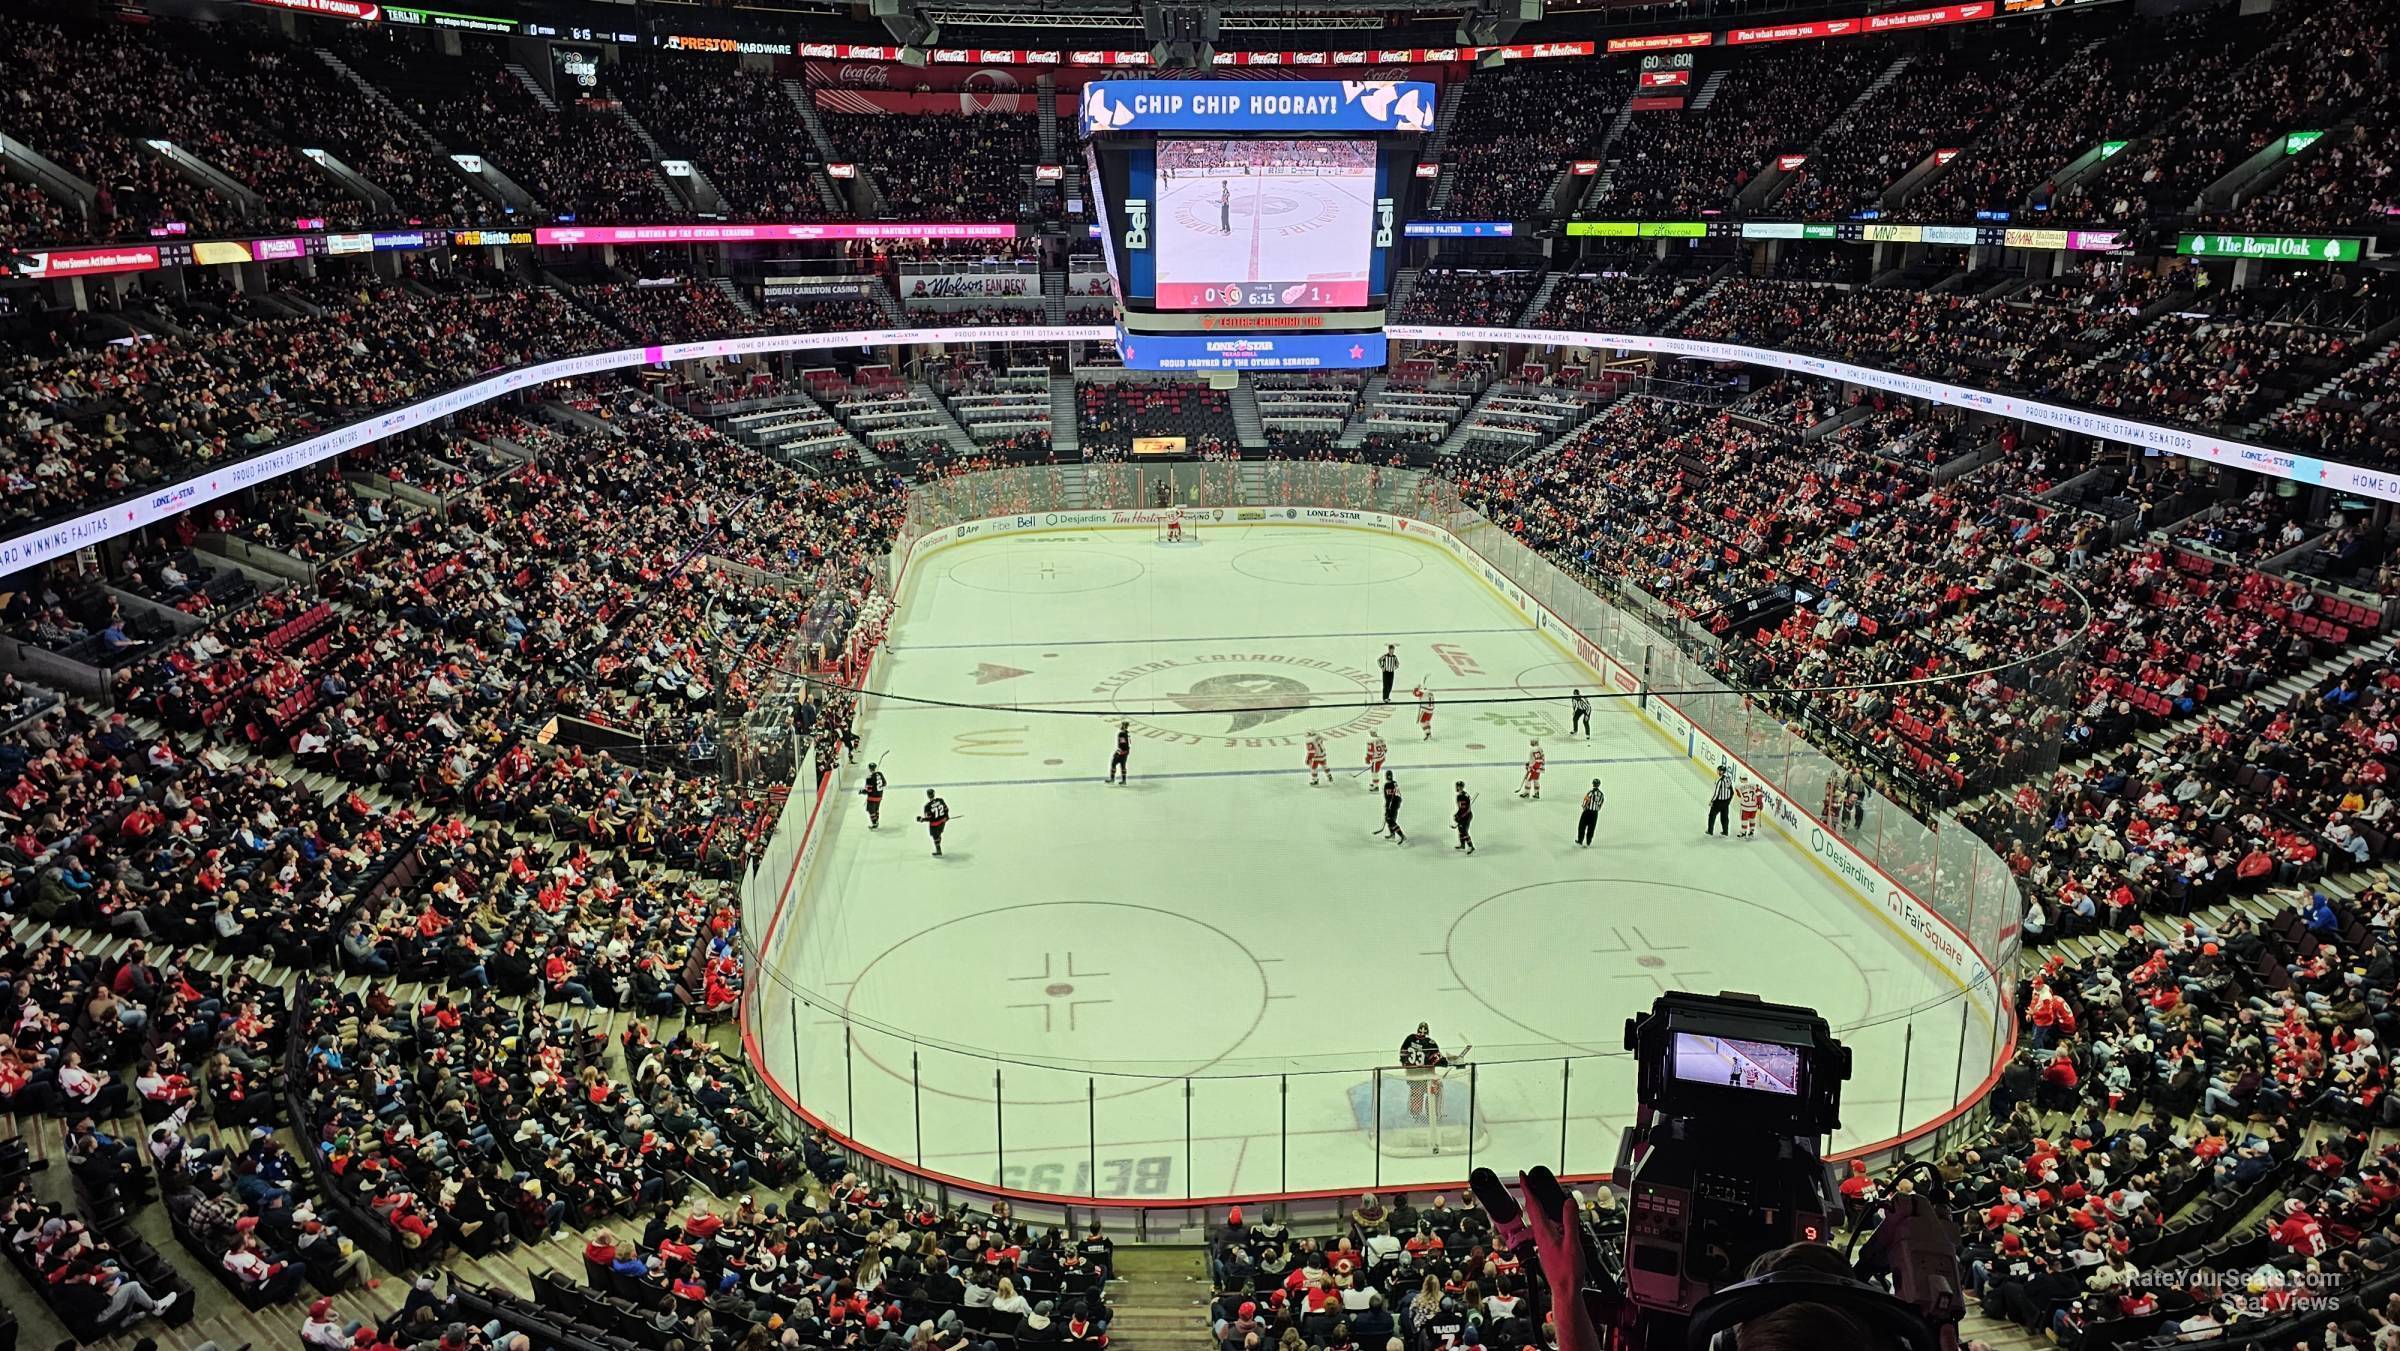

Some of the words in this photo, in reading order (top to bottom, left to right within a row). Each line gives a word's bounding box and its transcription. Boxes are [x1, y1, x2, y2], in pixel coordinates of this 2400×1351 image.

[1889, 16, 1907, 26] what
[1908, 14, 1930, 24] moves
[1931, 12, 1945, 22] you
[1755, 30, 1774, 39] what
[1774, 28, 1797, 38] moves
[1798, 26, 1812, 36] you
[679, 37, 736, 52] PRESTON
[736, 42, 791, 55] HARDWARE
[1627, 39, 1645, 48] what
[1646, 38, 1668, 47] moves
[1668, 37, 1683, 47] you
[1533, 45, 1550, 57] Tim
[1550, 45, 1582, 57] Hortons
[565, 62, 596, 76] SENS
[840, 65, 888, 83] Coca-Cola
[1135, 95, 1183, 114] CHIP
[1192, 95, 1240, 114] CHIP
[1251, 95, 1337, 114] HOORAY!
[1125, 199, 1147, 249] Bell
[1377, 198, 1394, 248] Bell
[1872, 227, 1898, 240] MNP
[1928, 227, 1970, 242] TechInsights
[2006, 232, 2034, 245] RE/MAX
[2217, 236, 2241, 252] The
[2242, 238, 2280, 257] Royal
[2282, 239, 2310, 256] Oak
[764, 285, 792, 296] RIDEAU
[793, 285, 831, 295] CARLETON
[832, 284, 859, 294] CASINO
[927, 277, 983, 296] Molson
[1205, 288, 1215, 301] 0
[1249, 294, 1275, 305] 6:15
[1312, 288, 1320, 301] 1
[1207, 342, 1235, 351] LONE
[1247, 341, 1273, 351] STAR
[1160, 358, 1186, 368] PROUD
[1188, 358, 1220, 368] PARTNER
[1222, 358, 1232, 367] OF
[1234, 358, 1249, 367] THE
[1251, 358, 1281, 367] OTTAWA
[1282, 357, 1320, 366] SENATORS
[2026, 406, 2047, 419] PROUD
[2051, 411, 2081, 426] PARTNER
[2084, 419, 2094, 428] OF
[2096, 422, 2110, 433] THE
[2113, 425, 2145, 439] OTTAWA
[2149, 432, 2191, 449] SENATORS
[232, 467, 255, 482] PROUD
[257, 458, 285, 476] PARTNER
[286, 454, 295, 466] OF
[295, 451, 307, 462] THE
[308, 442, 330, 457] OTTAWA
[331, 431, 358, 449] SENATORS
[2241, 450, 2264, 462] LONE
[2273, 457, 2295, 468] STAR
[2353, 474, 2384, 491] HOME
[178, 485, 195, 498] STAR
[1017, 516, 1036, 529] Bell
[1060, 514, 1106, 525] Desjardins
[1112, 511, 1129, 523] Tim
[1339, 512, 1360, 520] STAR
[23, 531, 67, 557] WINNING
[71, 517, 108, 539] FAJITAS
[1578, 638, 1600, 672] BRICK
[931, 804, 944, 818] 72
[1826, 841, 1876, 893] Desjardins
[1905, 905, 1963, 966] FairSquare
[1408, 1047, 1426, 1066] 33
[1805, 1227, 1817, 1240] 9
